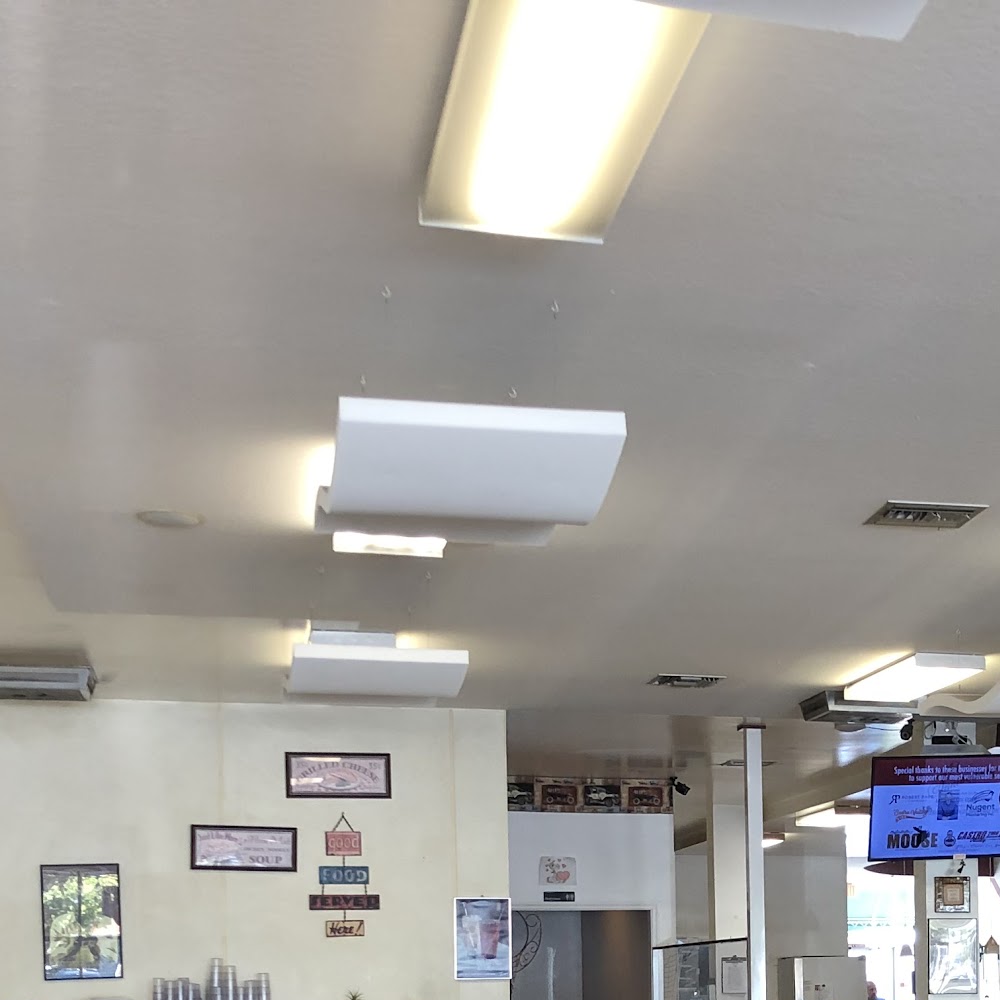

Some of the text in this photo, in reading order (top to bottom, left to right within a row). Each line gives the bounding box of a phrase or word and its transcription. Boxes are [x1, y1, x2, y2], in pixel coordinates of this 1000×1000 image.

[342, 762, 380, 782] CHEESE
[893, 766, 915, 776] Special
[915, 765, 934, 774] thanks
[935, 766, 942, 774] to
[942, 765, 958, 774] these
[958, 765, 988, 775] businesses
[988, 764, 997, 775] for
[915, 774, 938, 783] support
[966, 803, 996, 812] Nugent
[886, 832, 939, 849] MOOSE
[956, 830, 988, 840] CASTRO
[249, 855, 283, 864] SOUP
[322, 868, 368, 883] FOOD
[311, 895, 379, 908] SERVED
